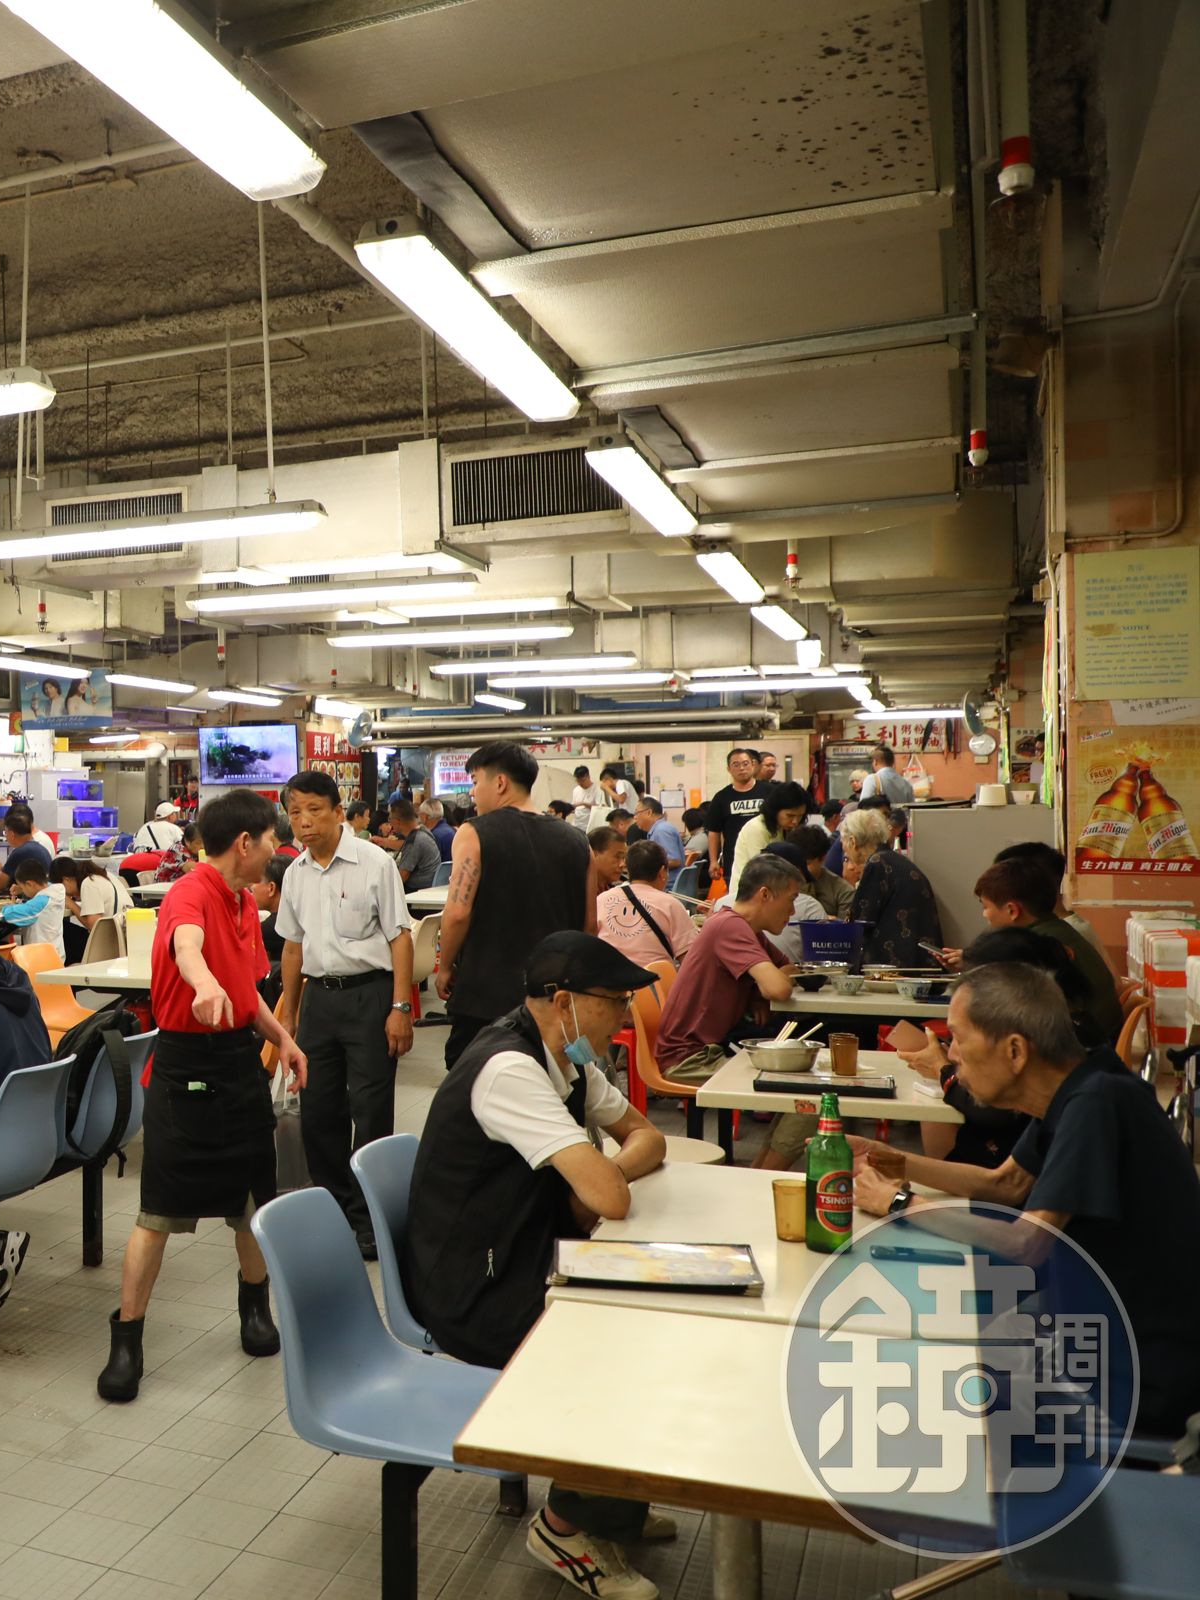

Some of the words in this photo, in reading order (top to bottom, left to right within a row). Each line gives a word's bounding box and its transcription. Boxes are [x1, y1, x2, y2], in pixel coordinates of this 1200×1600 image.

[1089, 768, 1113, 780] FRESH
[1081, 860, 1135, 871] 生力啤酒
[1140, 861, 1194, 872] 真正朋友
[812, 941, 832, 949] BLUE
